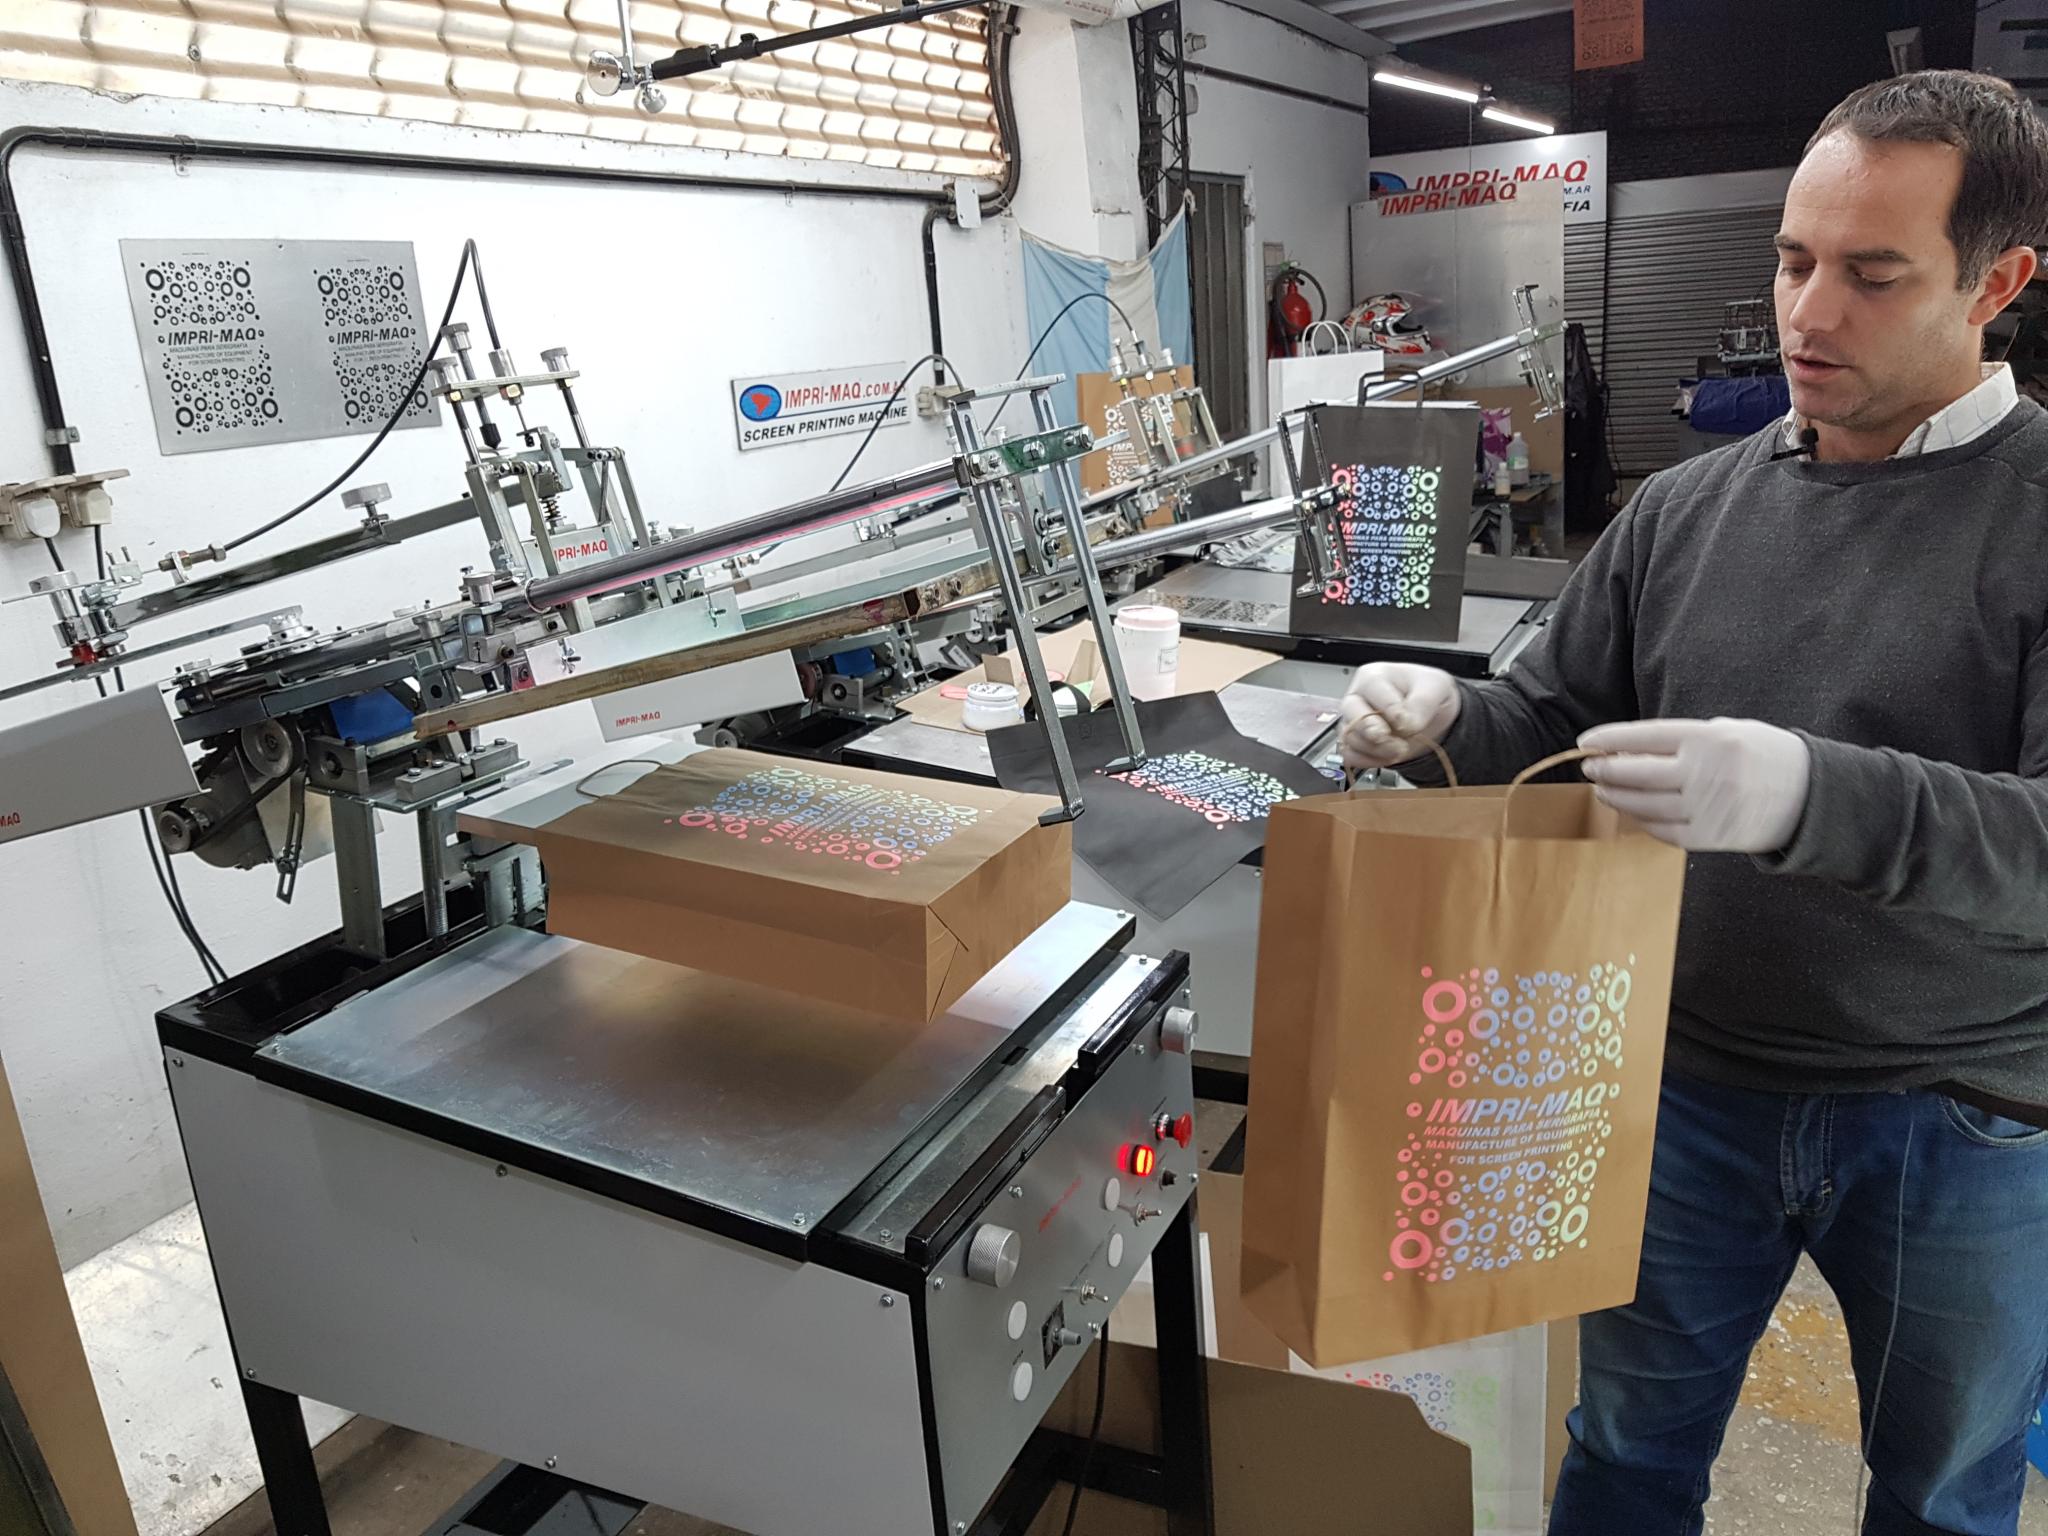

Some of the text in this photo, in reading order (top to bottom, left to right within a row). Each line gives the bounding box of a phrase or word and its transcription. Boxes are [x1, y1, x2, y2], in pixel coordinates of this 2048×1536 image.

[1381, 182, 1517, 216] IMPRI-MAQ
[168, 328, 256, 346] IMPRI-MAQ
[337, 327, 409, 345] IMPRI-MAQ
[744, 425, 795, 442] SCREEN
[798, 413, 855, 434] PRINTING
[616, 711, 661, 727] IMPRI-MAQ
[768, 785, 865, 837] IMPRI-MAQ
[1425, 1081, 1607, 1124] IMPRI-MAQ
[1424, 1107, 1600, 1137] MAQUINAS PARA SERIGRAFIA
[1426, 1138, 1517, 1150] MANUFACTURE
[1536, 1121, 1594, 1142] EQUIPMENT
[1449, 1139, 1573, 1165] FOR SCREEN PRINTING
